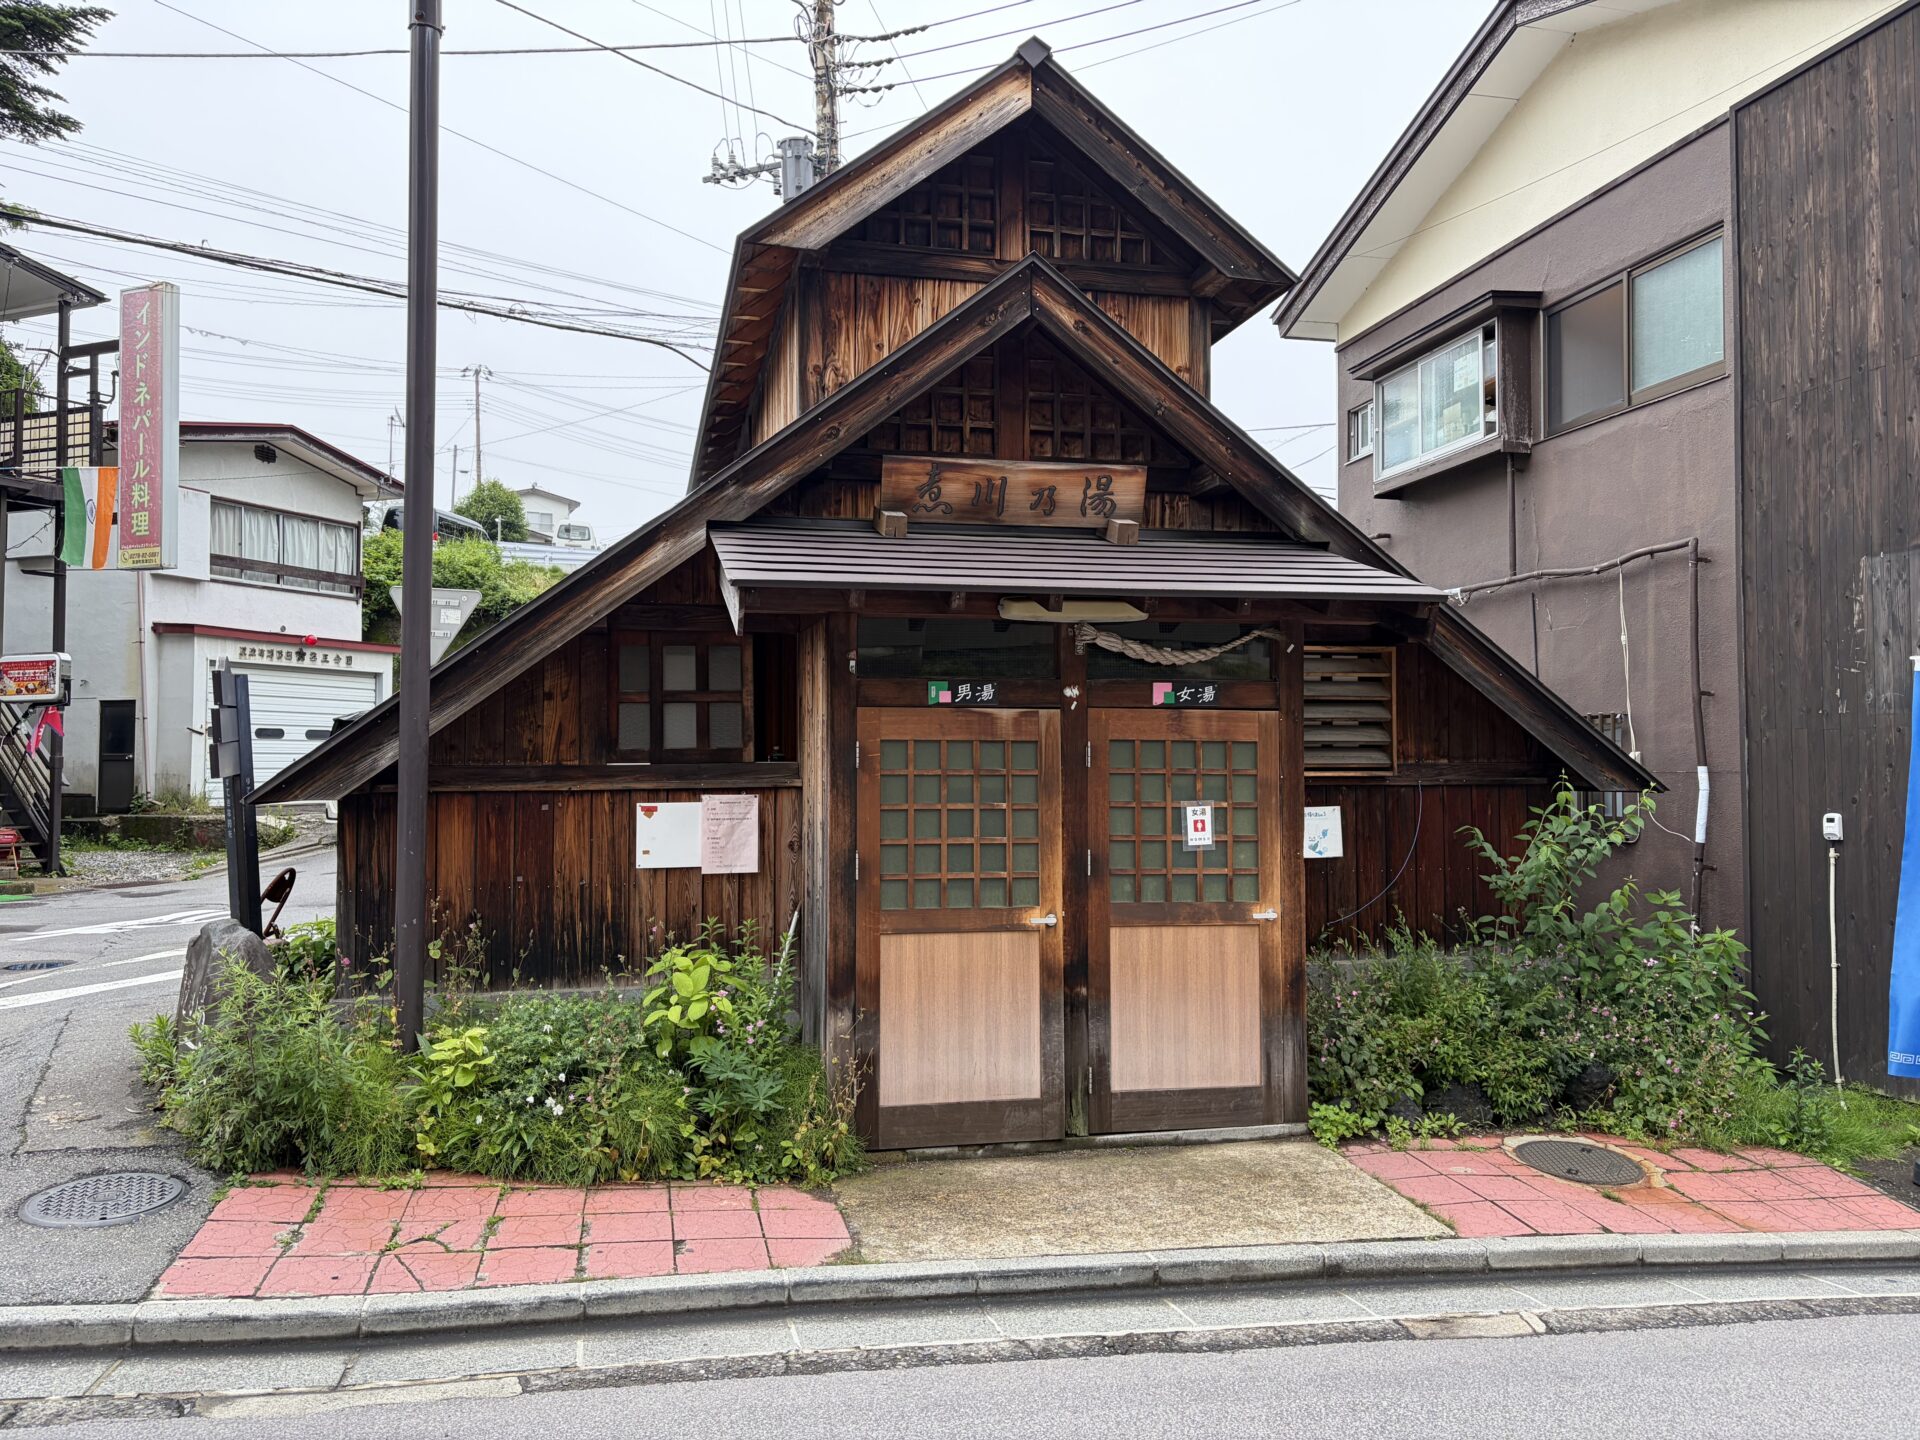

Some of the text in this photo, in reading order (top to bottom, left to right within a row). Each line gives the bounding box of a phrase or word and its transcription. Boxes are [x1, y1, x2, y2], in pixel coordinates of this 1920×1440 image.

[131, 301, 152, 536] インドネパール料理
[912, 462, 1117, 519] 煮川乃湯
[955, 683, 995, 703] 男湯
[1176, 685, 1216, 704] 女湯
[1192, 807, 1207, 817] 女湯
